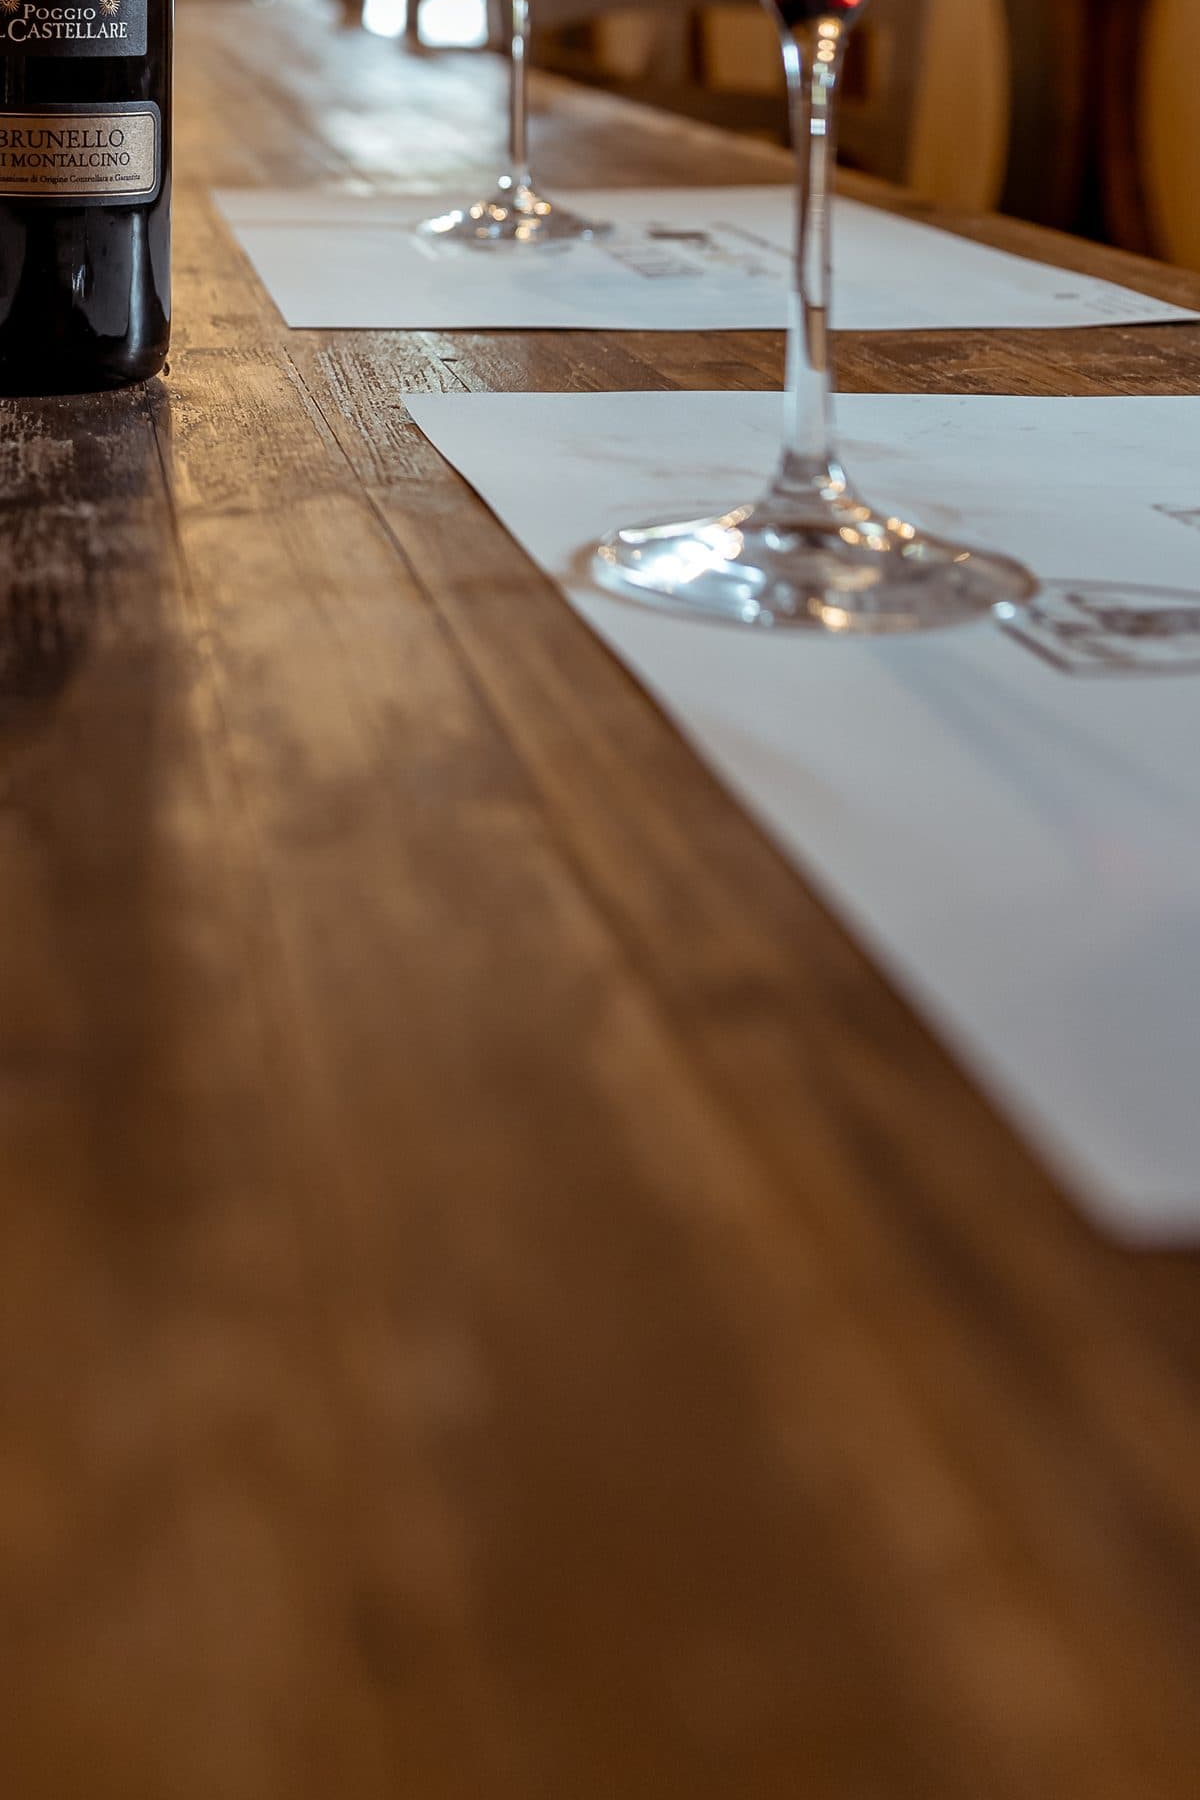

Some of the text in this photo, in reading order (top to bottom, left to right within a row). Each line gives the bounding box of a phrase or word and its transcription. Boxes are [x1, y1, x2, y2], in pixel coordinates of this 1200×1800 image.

[24, 4, 96, 21] POGGIO
[8, 18, 128, 42] CASTELLARE
[10, 152, 130, 168] MONTALCINO
